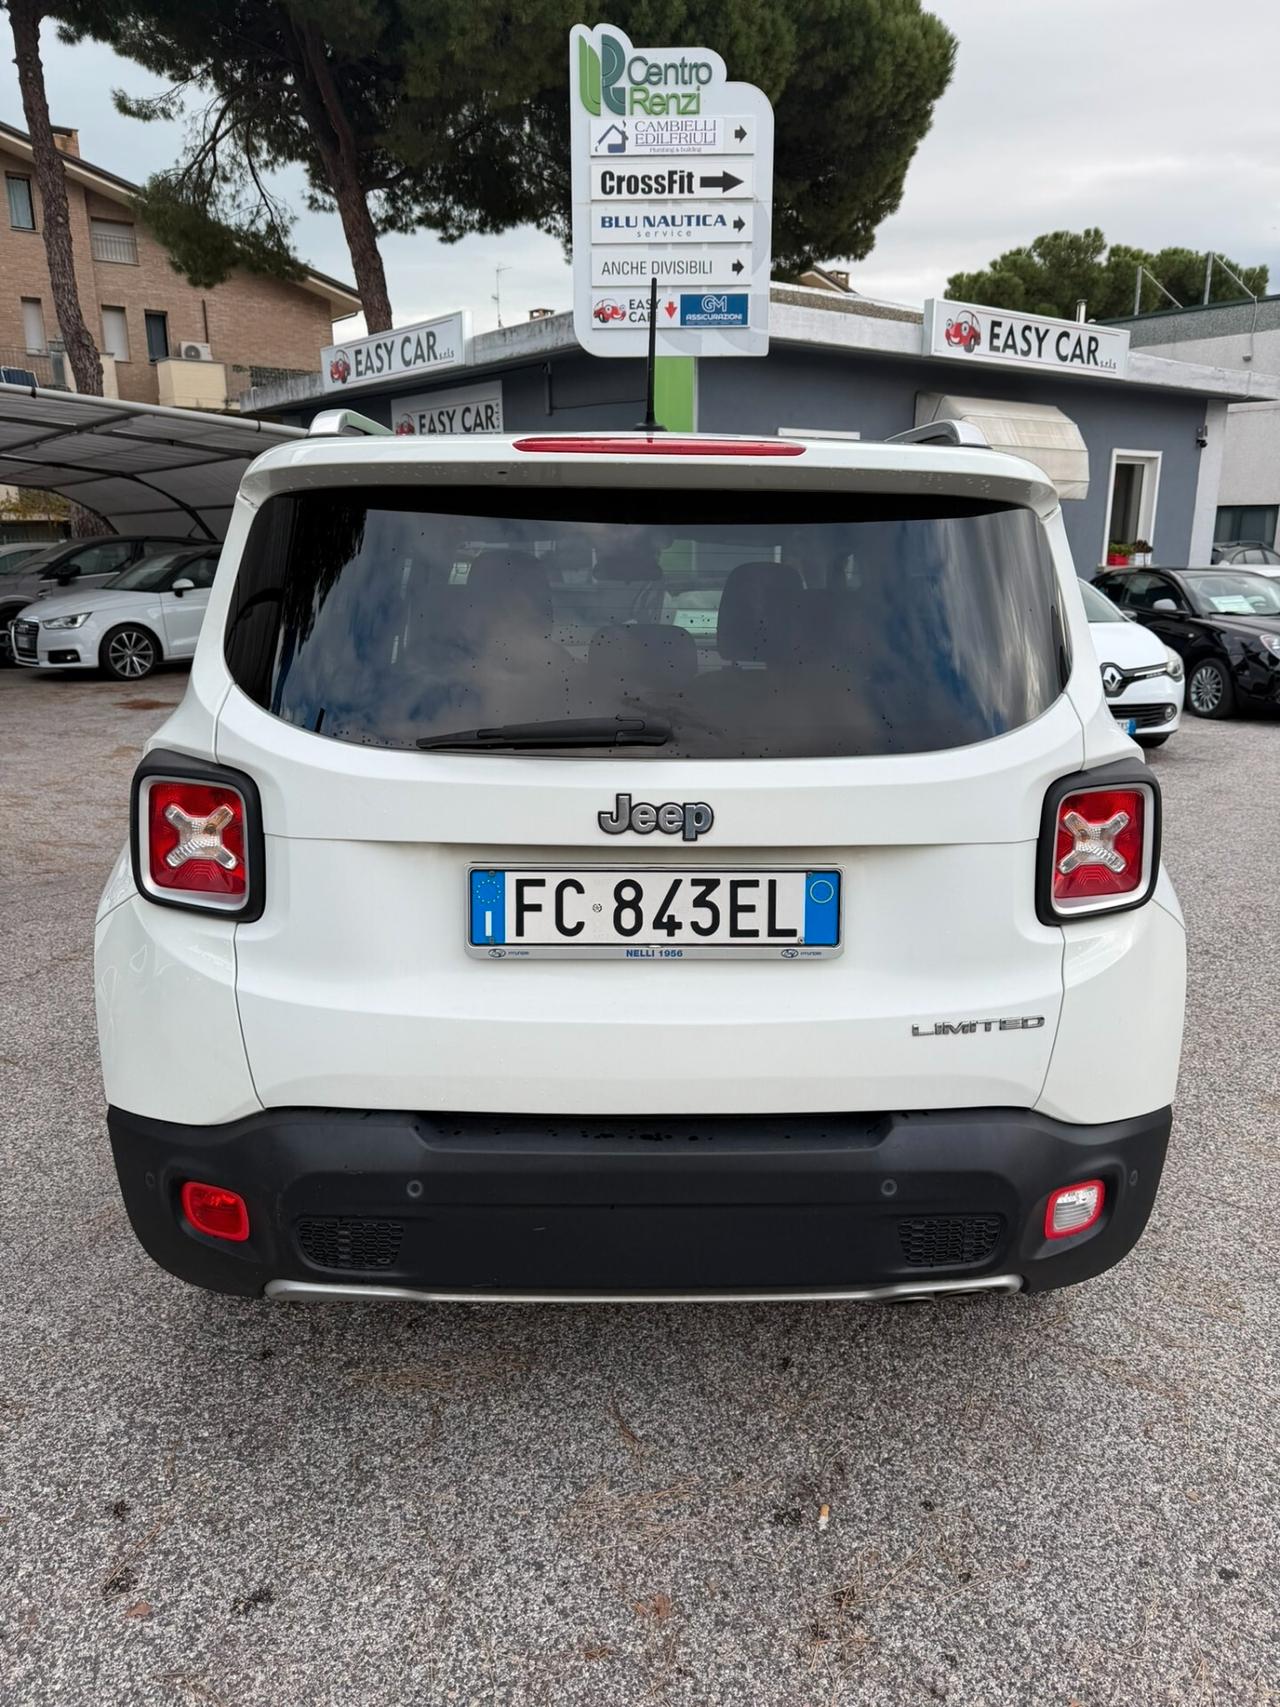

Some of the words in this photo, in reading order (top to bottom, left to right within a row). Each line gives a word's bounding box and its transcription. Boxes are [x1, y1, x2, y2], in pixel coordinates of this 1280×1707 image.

[627, 55, 713, 86] Centro
[629, 85, 701, 116] Renzi
[634, 119, 717, 132] CAMBIELLI
[634, 132, 717, 145] EDILFRIULI
[600, 169, 695, 196] CrossFit
[601, 215, 638, 228] BLU
[642, 214, 727, 228] NAUTICA
[637, 229, 692, 238] service
[601, 260, 647, 275] ANCHE
[651, 260, 713, 275] DIVISIBILI
[701, 294, 728, 313] GM
[354, 340, 395, 377] EASY
[401, 331, 439, 368] CAR
[989, 319, 1050, 358] EASY
[1055, 330, 1099, 366] CAR
[418, 409, 457, 434] EASY
[461, 404, 496, 433] CAR
[597, 793, 714, 841] Jeep
[514, 878, 586, 938] FC
[612, 877, 798, 938] 843EL
[626, 949, 655, 957] NELLI
[658, 949, 683, 957] 1956
[911, 1016, 1046, 1037] LIMITED
